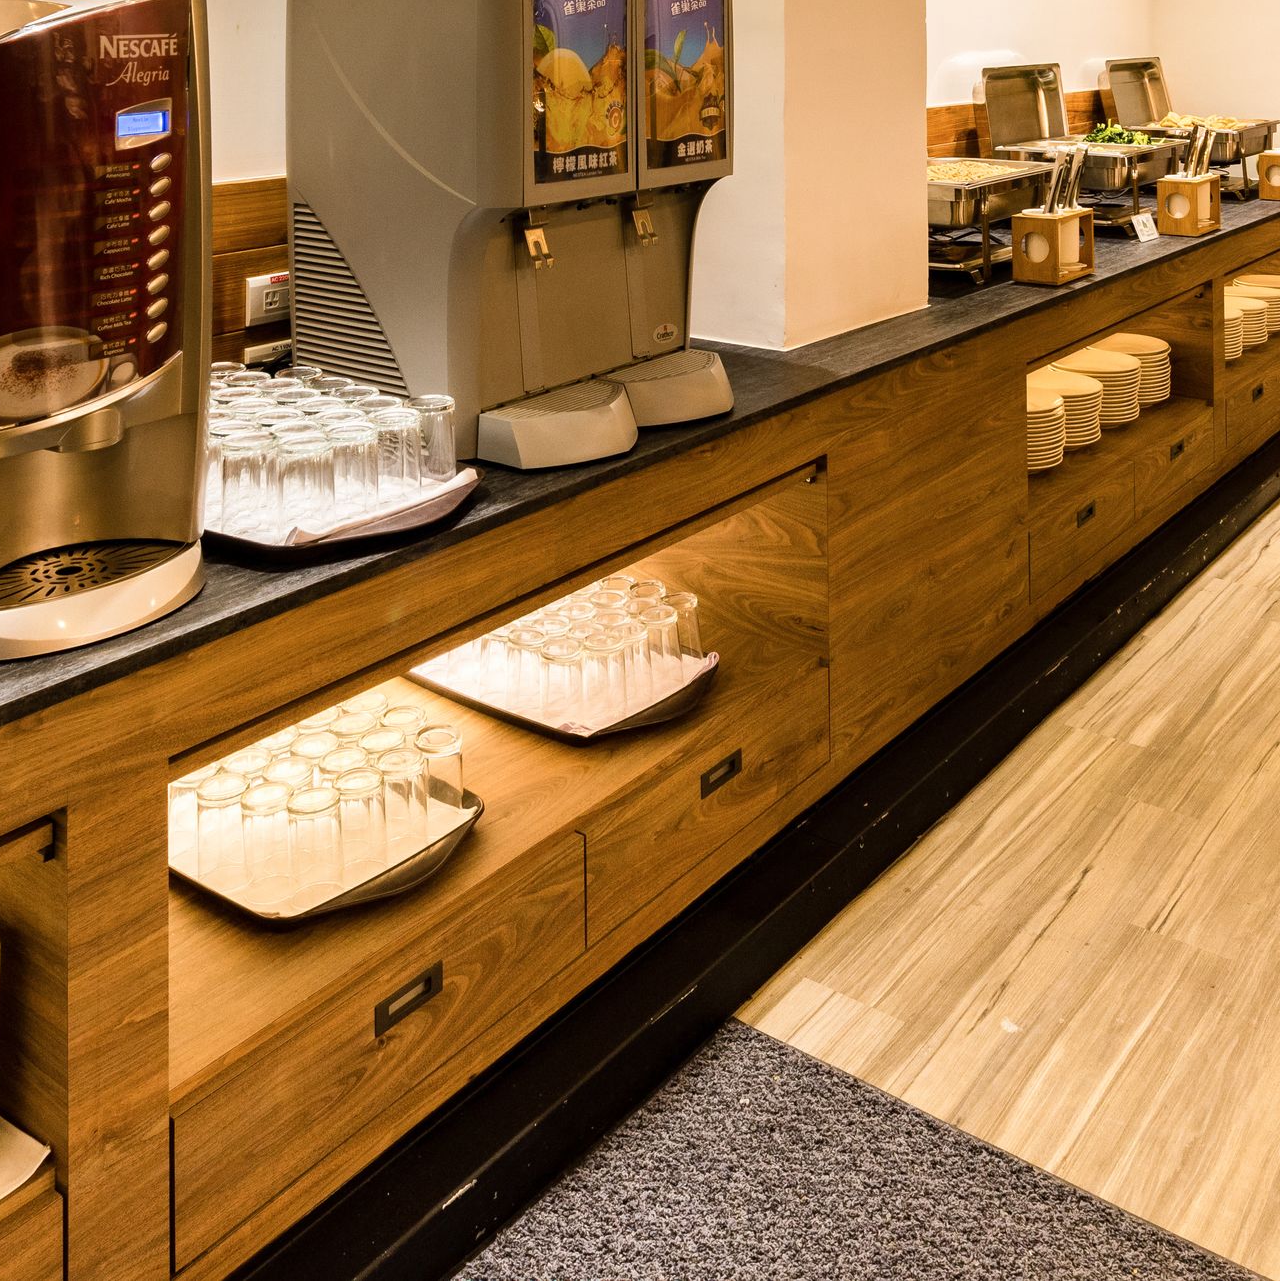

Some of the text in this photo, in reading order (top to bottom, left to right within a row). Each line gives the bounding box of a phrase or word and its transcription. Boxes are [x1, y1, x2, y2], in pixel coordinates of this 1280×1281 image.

[99, 33, 178, 59] NESCAFÉ
[105, 61, 170, 87] Alegria
[552, 151, 618, 174] 檸檬風味紅茶
